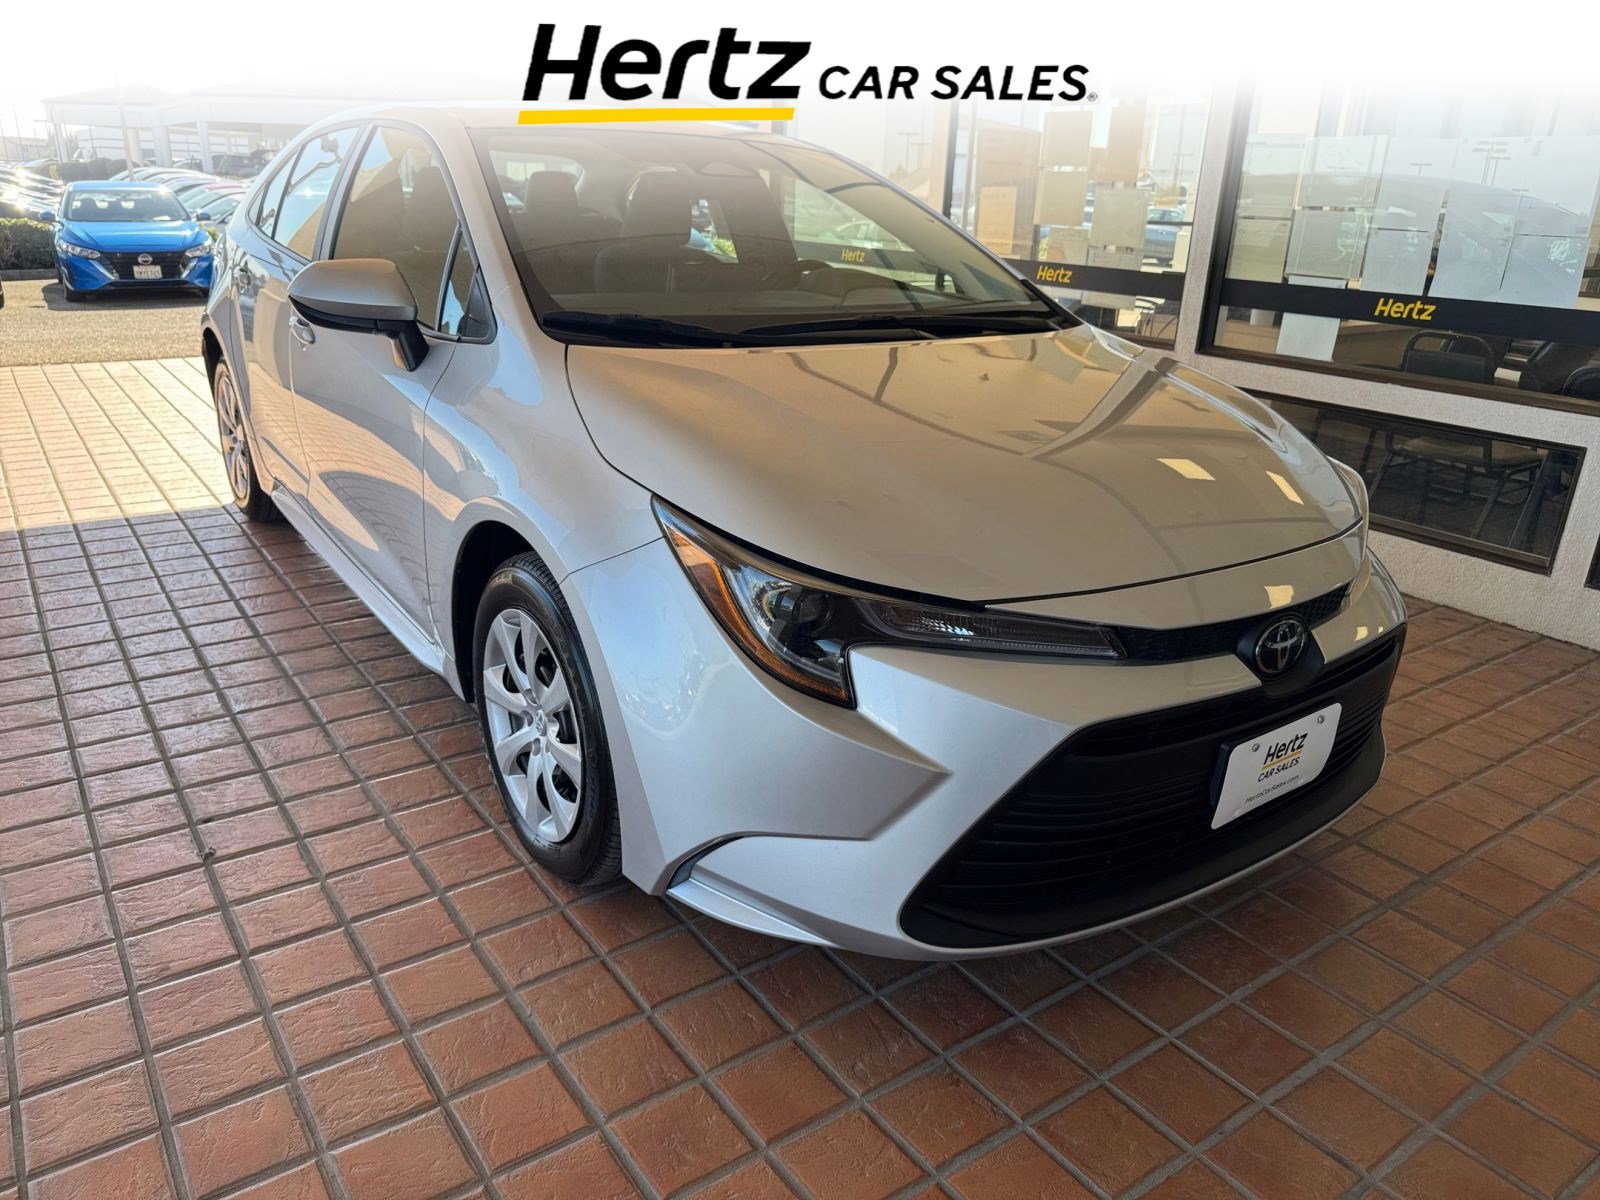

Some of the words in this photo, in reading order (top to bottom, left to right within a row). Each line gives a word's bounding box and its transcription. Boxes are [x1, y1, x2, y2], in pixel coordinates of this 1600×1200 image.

[841, 247, 865, 263] Hertz
[1036, 265, 1072, 283] Hertz
[1374, 297, 1437, 320] Hertz
[1263, 732, 1308, 765] Hertz
[1257, 767, 1275, 782] CAR
[1274, 756, 1300, 775] SALES
